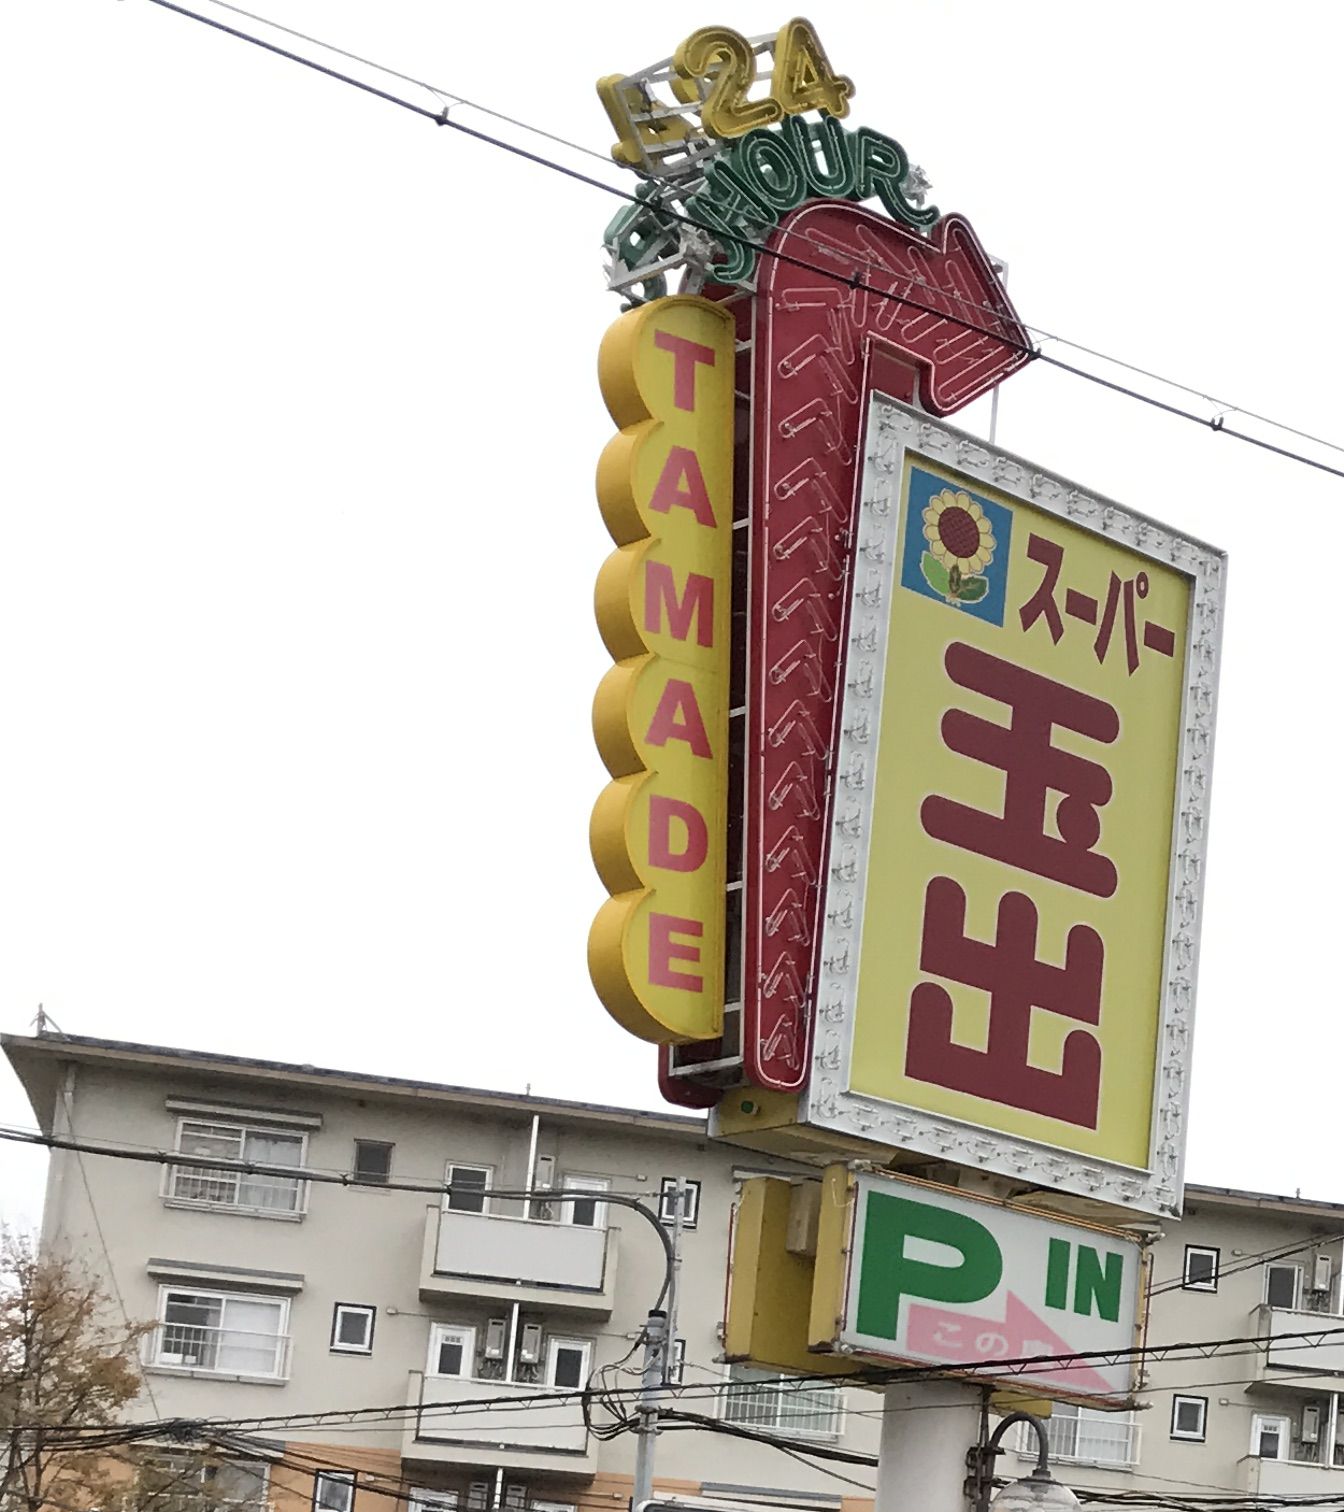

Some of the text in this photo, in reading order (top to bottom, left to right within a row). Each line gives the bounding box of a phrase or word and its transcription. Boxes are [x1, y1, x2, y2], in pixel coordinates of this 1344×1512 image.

[672, 16, 857, 139] 24
[690, 115, 941, 285] HOUR
[644, 329, 718, 993] TAMADE
[1019, 532, 1176, 677] スーパー
[905, 641, 1120, 1131] 玉出
[856, 1190, 1124, 1341] P IN
